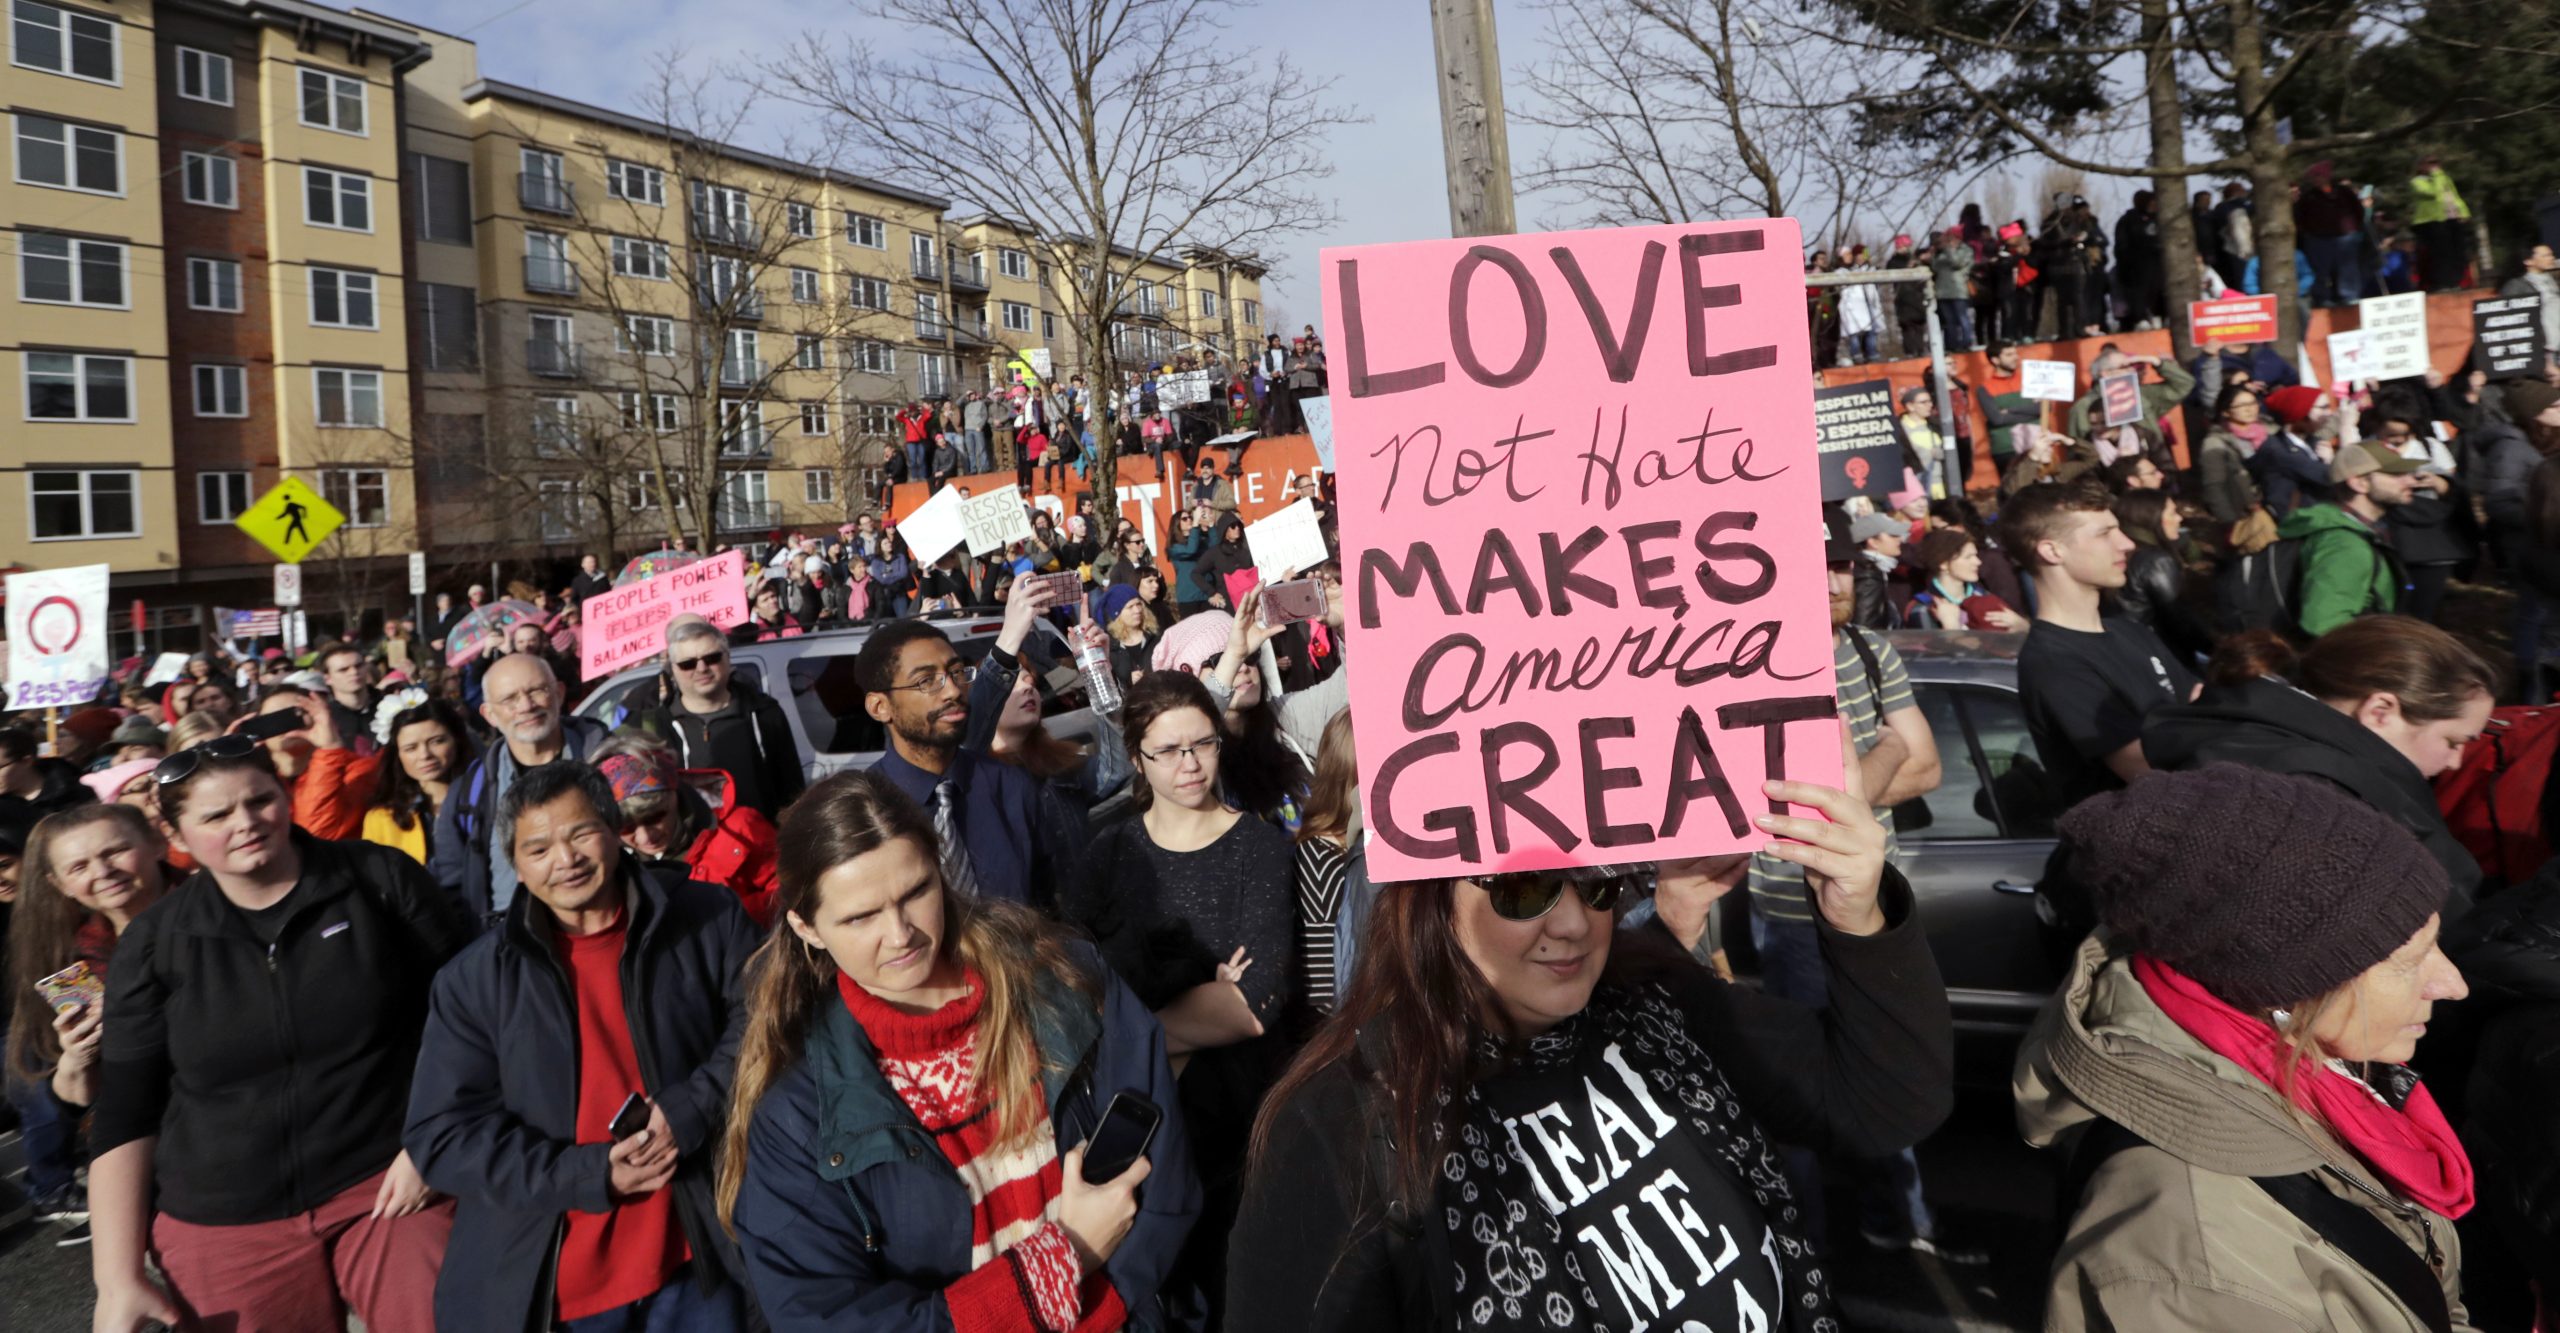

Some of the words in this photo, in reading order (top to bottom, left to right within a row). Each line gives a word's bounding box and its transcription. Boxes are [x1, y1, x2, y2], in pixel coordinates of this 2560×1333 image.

[1337, 230, 1777, 397] LOVE
[1815, 393, 1870, 412] ESPETA
[1871, 390, 1889, 403] MI
[1816, 405, 1891, 425] XISTENCIA
[1827, 419, 1895, 440] ESPERA
[1577, 404, 1789, 511] Hate
[960, 488, 1019, 526] RESIST
[968, 510, 1023, 547] TRUMP
[593, 581, 661, 620] PEOPLE
[672, 560, 728, 591] POWER
[1359, 511, 1777, 629] MAKES
[609, 606, 667, 637] FLIPS
[680, 590, 713, 610] THE
[593, 632, 655, 668] BALANCE
[1370, 696, 1838, 864] GREAT
[1578, 1168, 1741, 1333] ME
